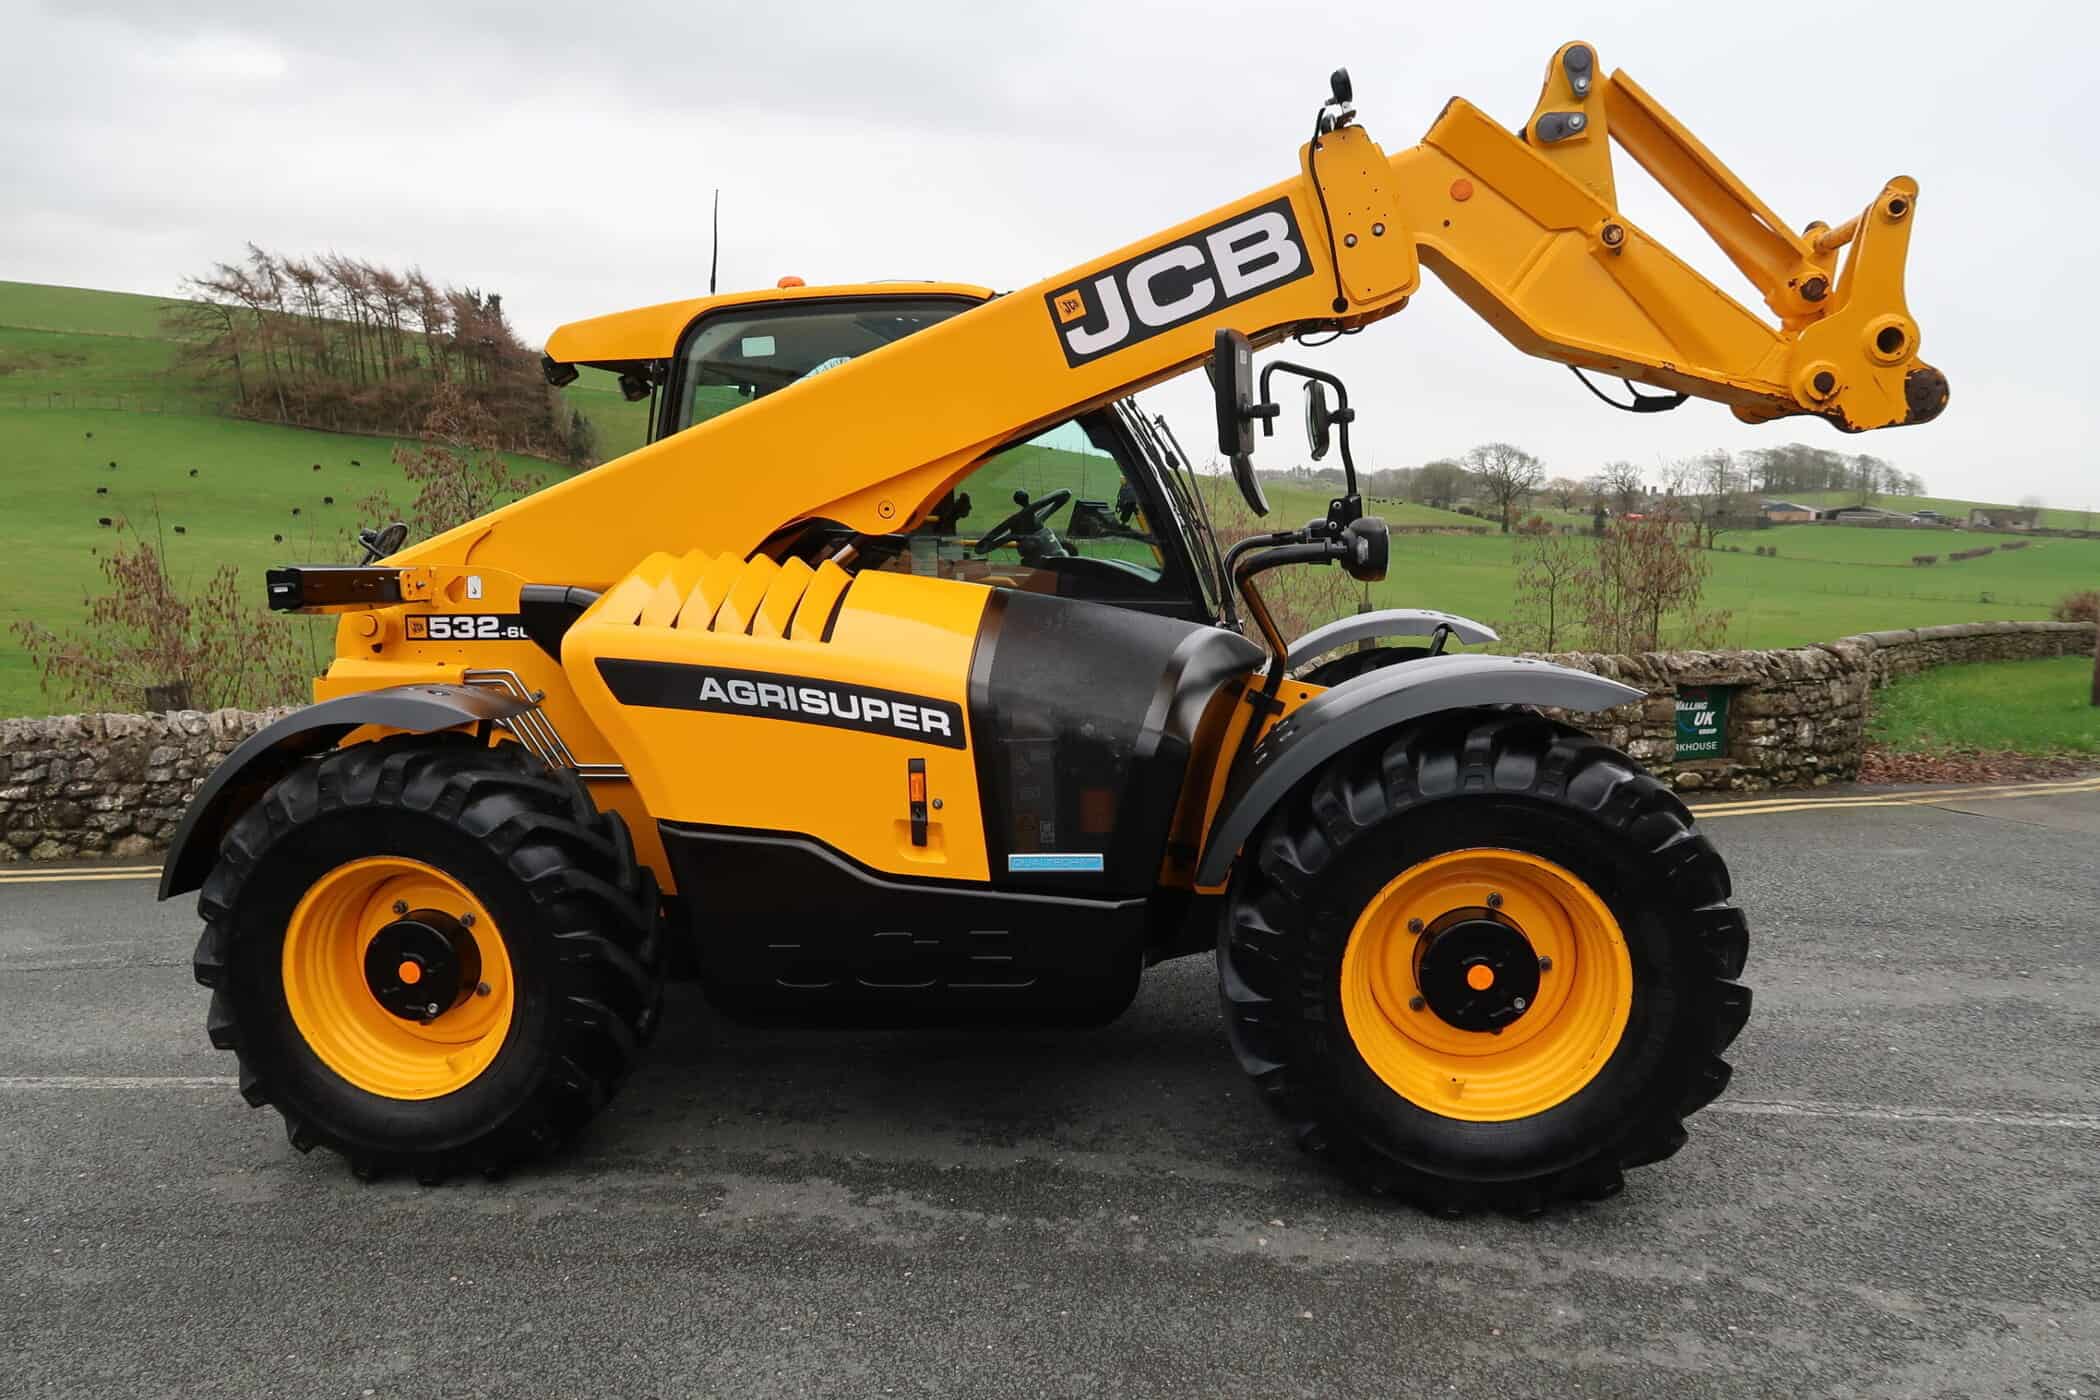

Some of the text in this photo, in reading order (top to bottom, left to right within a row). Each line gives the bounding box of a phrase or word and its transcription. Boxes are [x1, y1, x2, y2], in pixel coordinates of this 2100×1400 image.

[1066, 212, 1301, 354] JCB
[700, 677, 952, 737] AGRISUPER
[1694, 711, 1716, 726] UK
